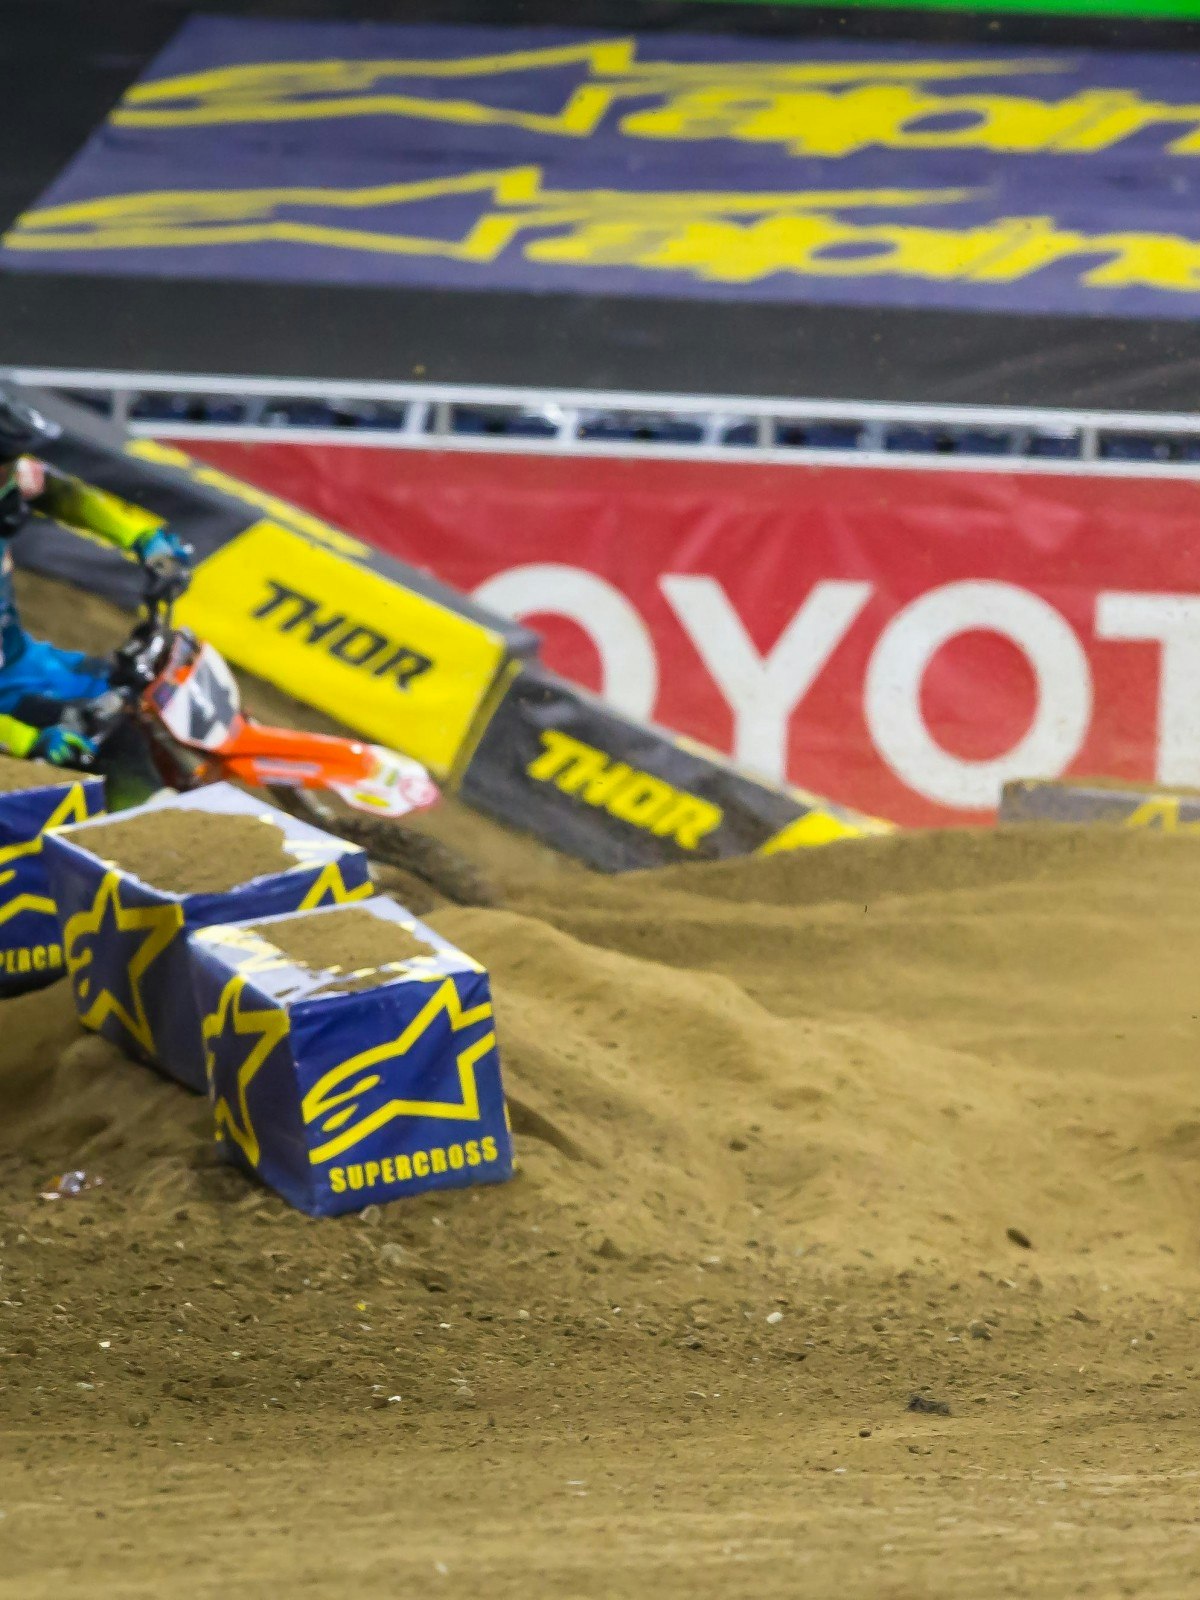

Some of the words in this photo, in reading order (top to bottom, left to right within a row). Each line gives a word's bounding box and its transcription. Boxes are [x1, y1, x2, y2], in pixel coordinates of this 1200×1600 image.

[247, 578, 434, 692] THOR
[527, 729, 725, 850] THOR
[328, 1136, 498, 1193] SUPERCROSS
